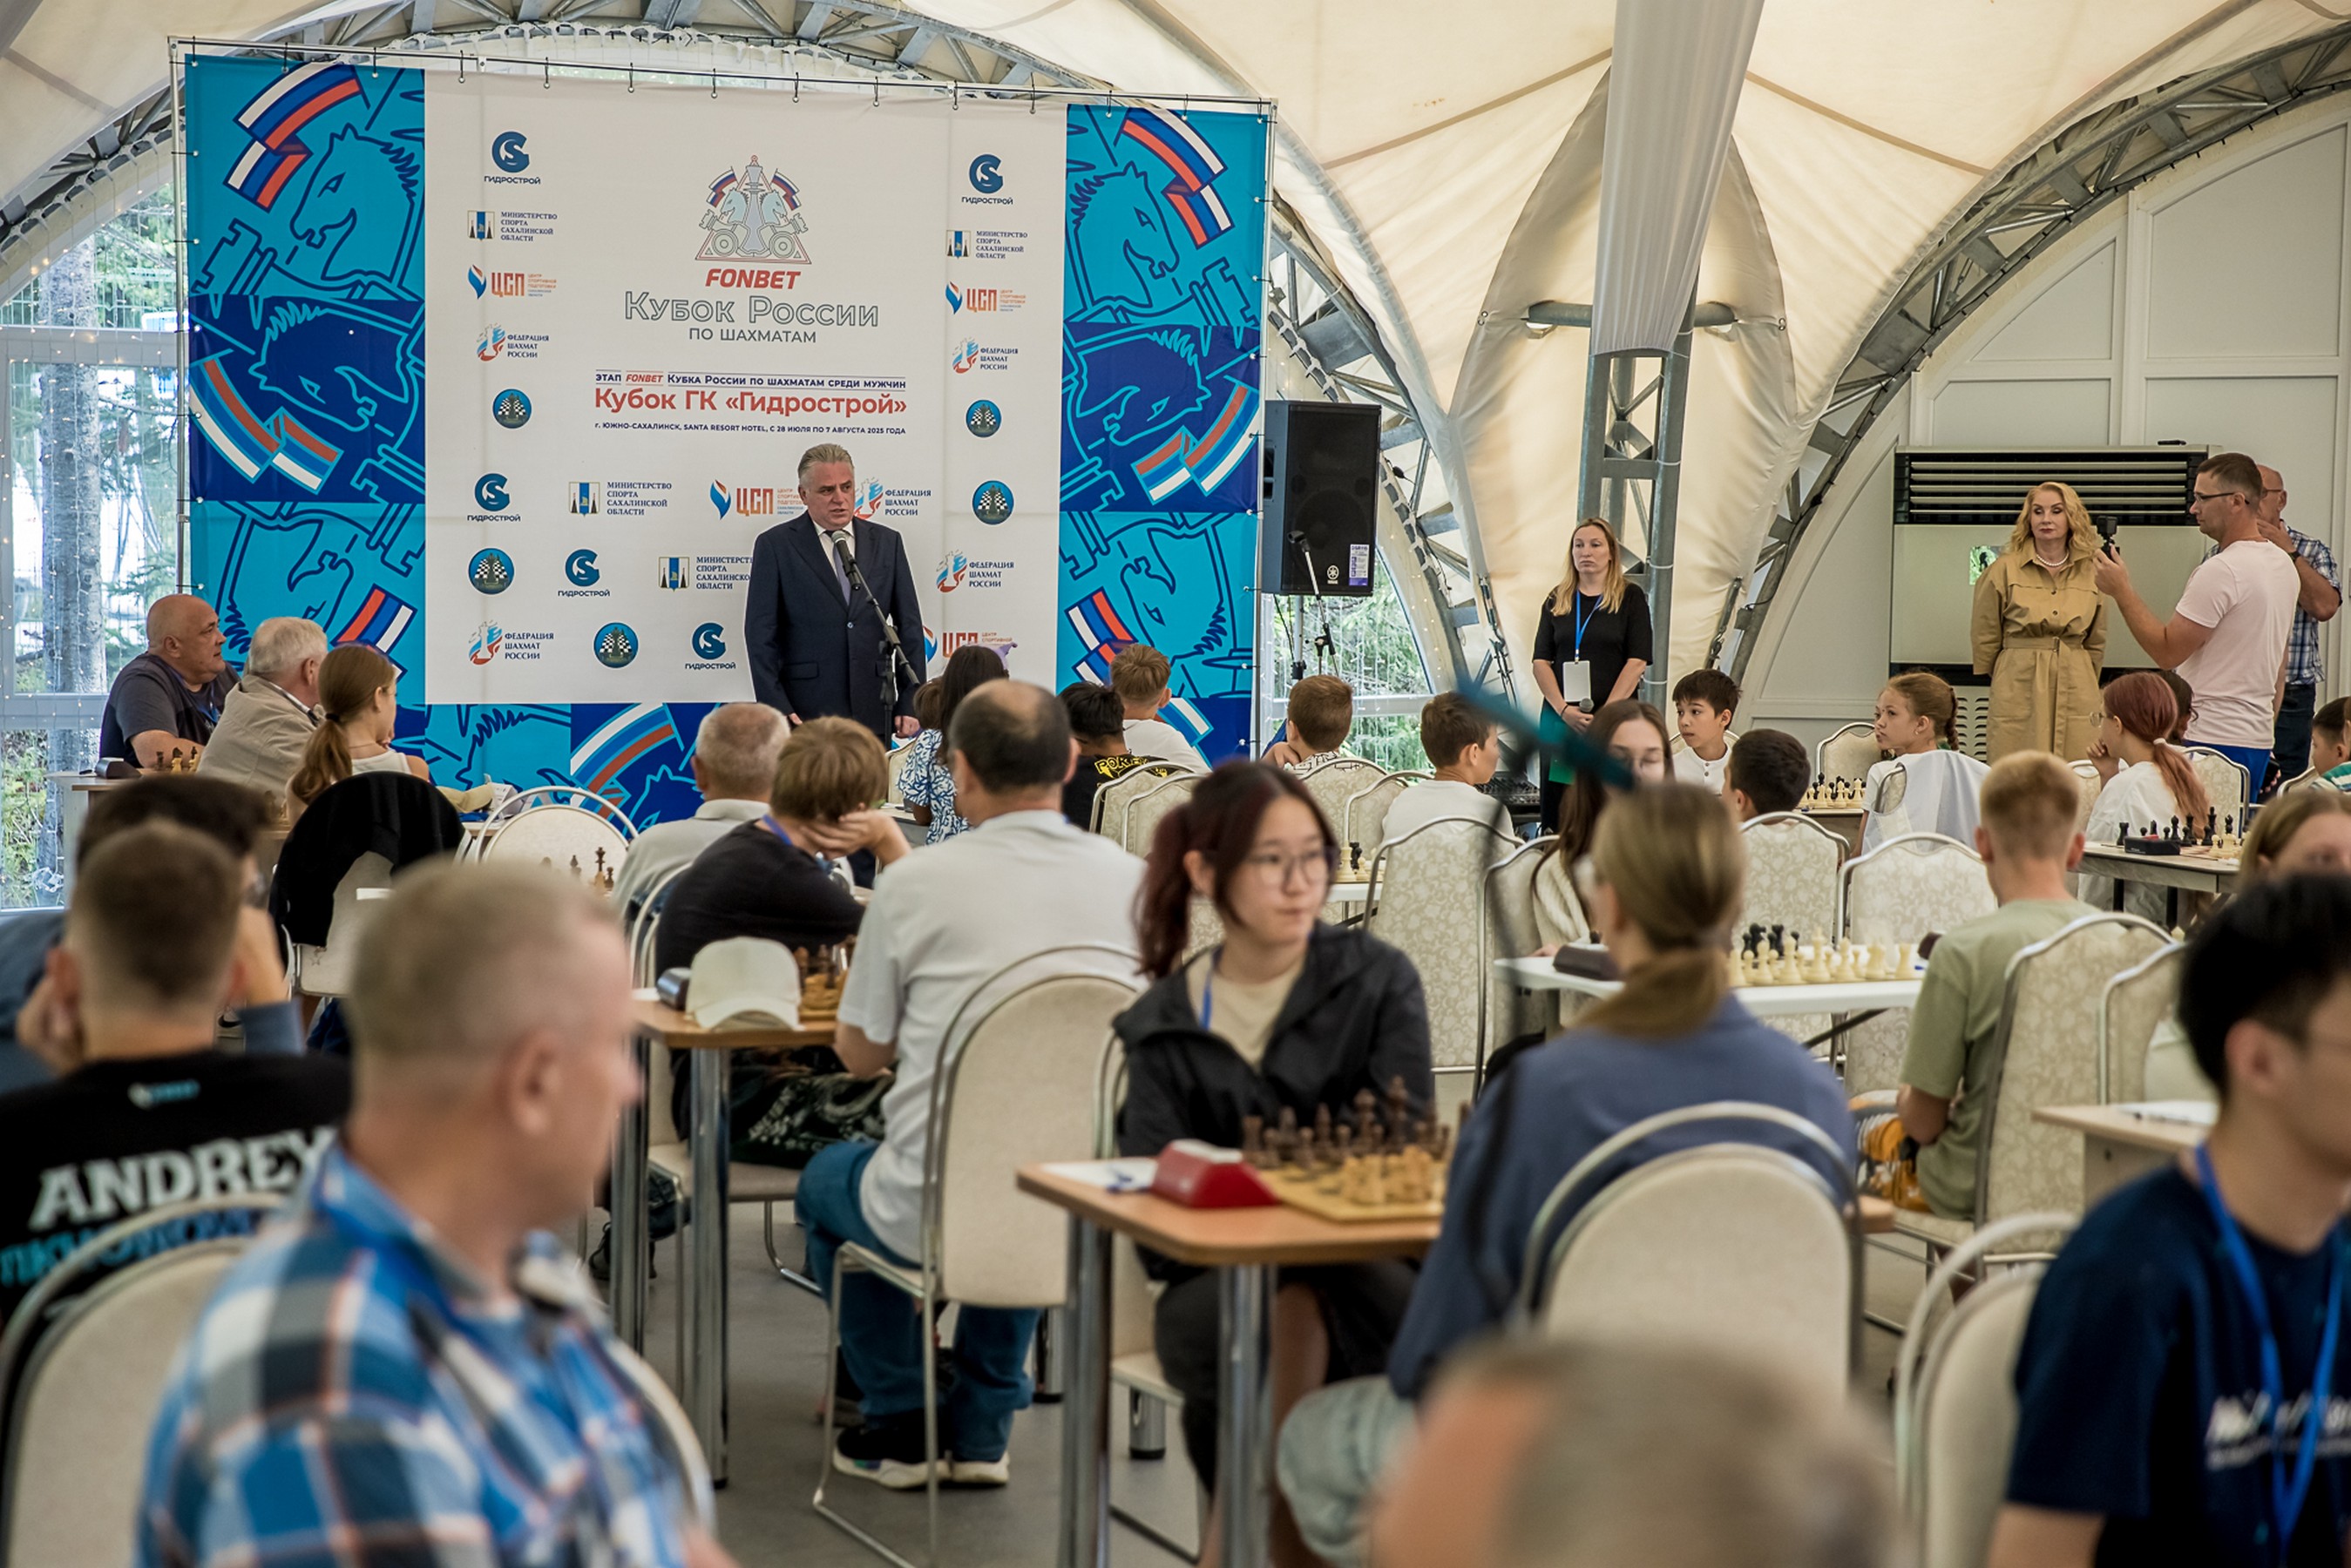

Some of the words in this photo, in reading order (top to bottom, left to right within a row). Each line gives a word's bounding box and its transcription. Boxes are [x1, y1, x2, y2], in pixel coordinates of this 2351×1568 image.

[484, 175, 540, 185] ГИДРОСТРОЙ
[961, 196, 1013, 206] ГИДРОСТРОЙ
[501, 211, 558, 220] МИНИСТЕРСТВО
[501, 226, 553, 235] САХАЛИНСКОЙ
[705, 268, 801, 289] FONBET
[491, 272, 525, 298] ЦСП
[966, 288, 997, 313] ЦСП
[507, 334, 549, 342] ФЕДЕРАЦИЯ
[720, 328, 816, 343] ШАХМАТАМ
[626, 374, 664, 383] FONBET
[595, 387, 676, 413] Кубок
[686, 390, 717, 410] ГК
[726, 390, 907, 418] «Гидрострой»
[607, 481, 672, 490] МИНИСТЕРСТВО
[884, 489, 932, 497] ФЕДЕРАЦИЯ
[607, 498, 667, 507] САХАЛИНСКОЙ
[735, 487, 774, 517] ЦСП
[884, 498, 919, 507] ШАХМАТ
[884, 508, 918, 517] РОССИИ
[467, 513, 521, 522] ГИДРОСТРОЙ
[696, 556, 754, 564] МИНИСТЕРСТ
[969, 561, 1014, 570] ФЕДЕРАЦИЯ
[696, 572, 750, 582] САХАЛИНСКО
[558, 589, 610, 598] ГИДРОСТРОЙ
[505, 632, 554, 640] ФЕДЕРАЦИЯ
[505, 652, 540, 660] РОССИИ
[685, 661, 736, 671] ГИДРОСТРОЙ
[28, 1126, 338, 1230] ANDREY
